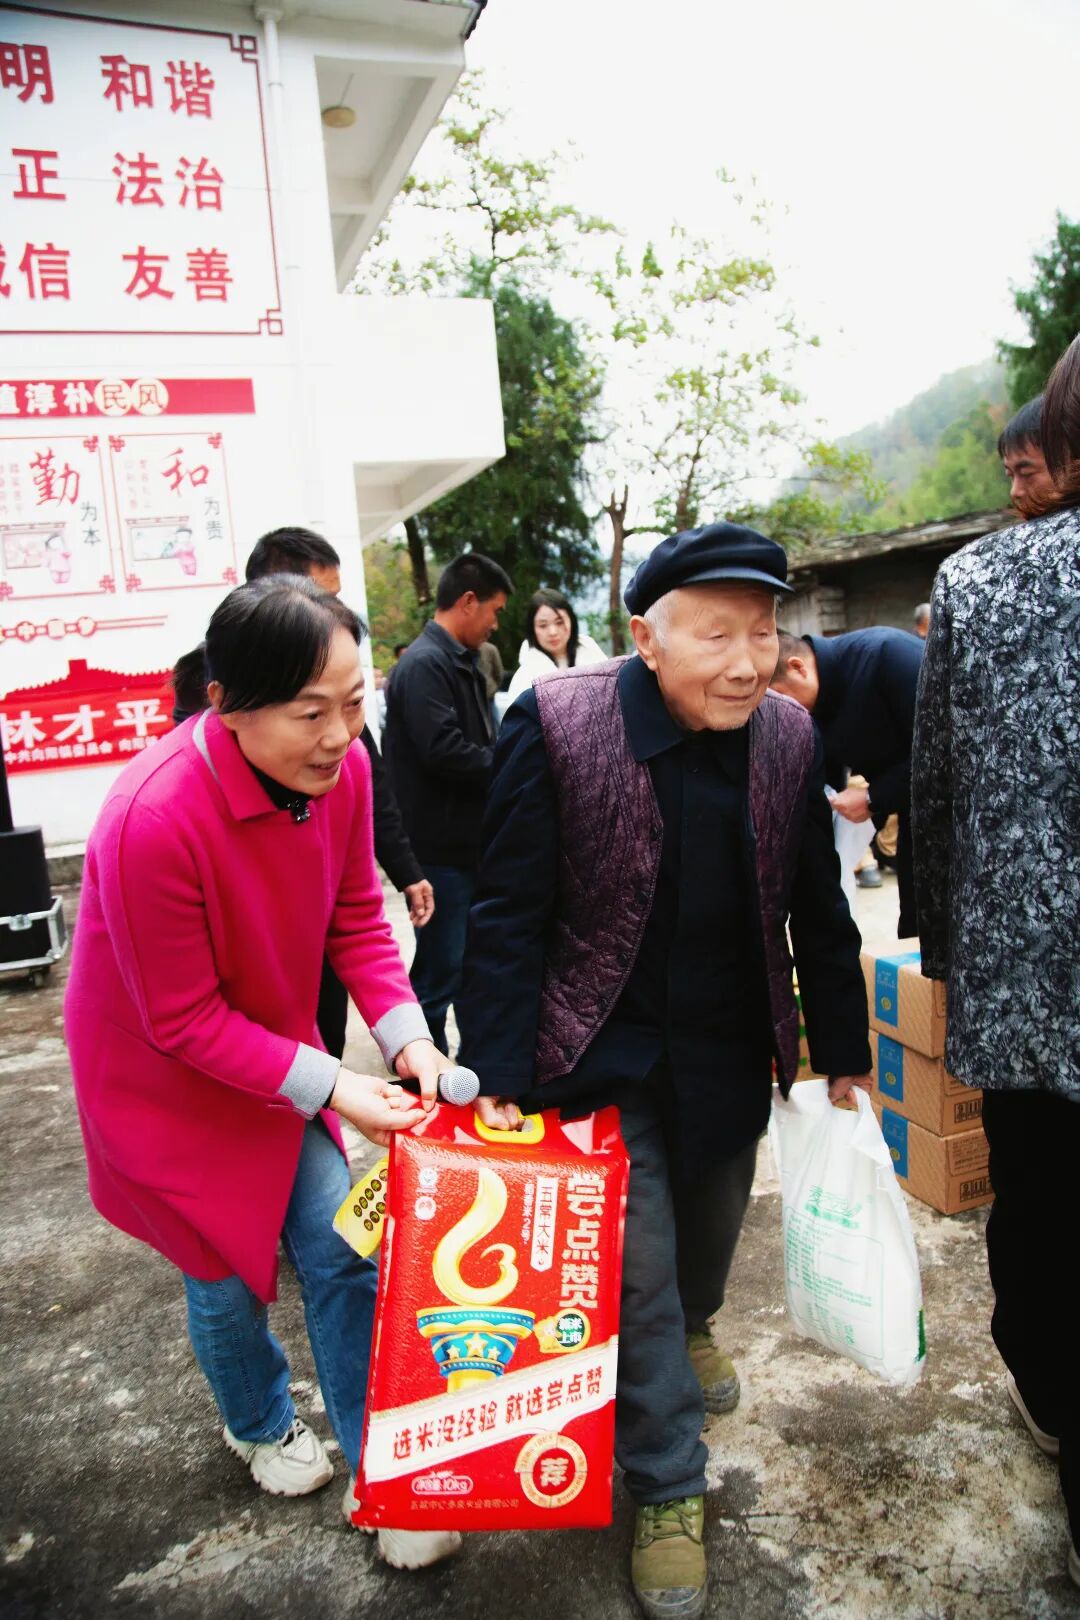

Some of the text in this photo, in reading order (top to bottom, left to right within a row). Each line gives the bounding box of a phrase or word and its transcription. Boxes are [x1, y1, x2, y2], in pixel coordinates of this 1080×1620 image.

[0, 41, 216, 119] 明 和谐
[11, 147, 224, 211] 正 法治
[0, 241, 234, 303] 信 友善
[29, 448, 81, 507] 勤
[161, 447, 211, 498] 和
[80, 501, 101, 546] 为本
[203, 496, 224, 541] 为贵
[536, 1185, 553, 1256] 五常大米
[559, 1171, 606, 1308] 尝点赞
[392, 1366, 602, 1461] 选米没经验 就选尝点赞
